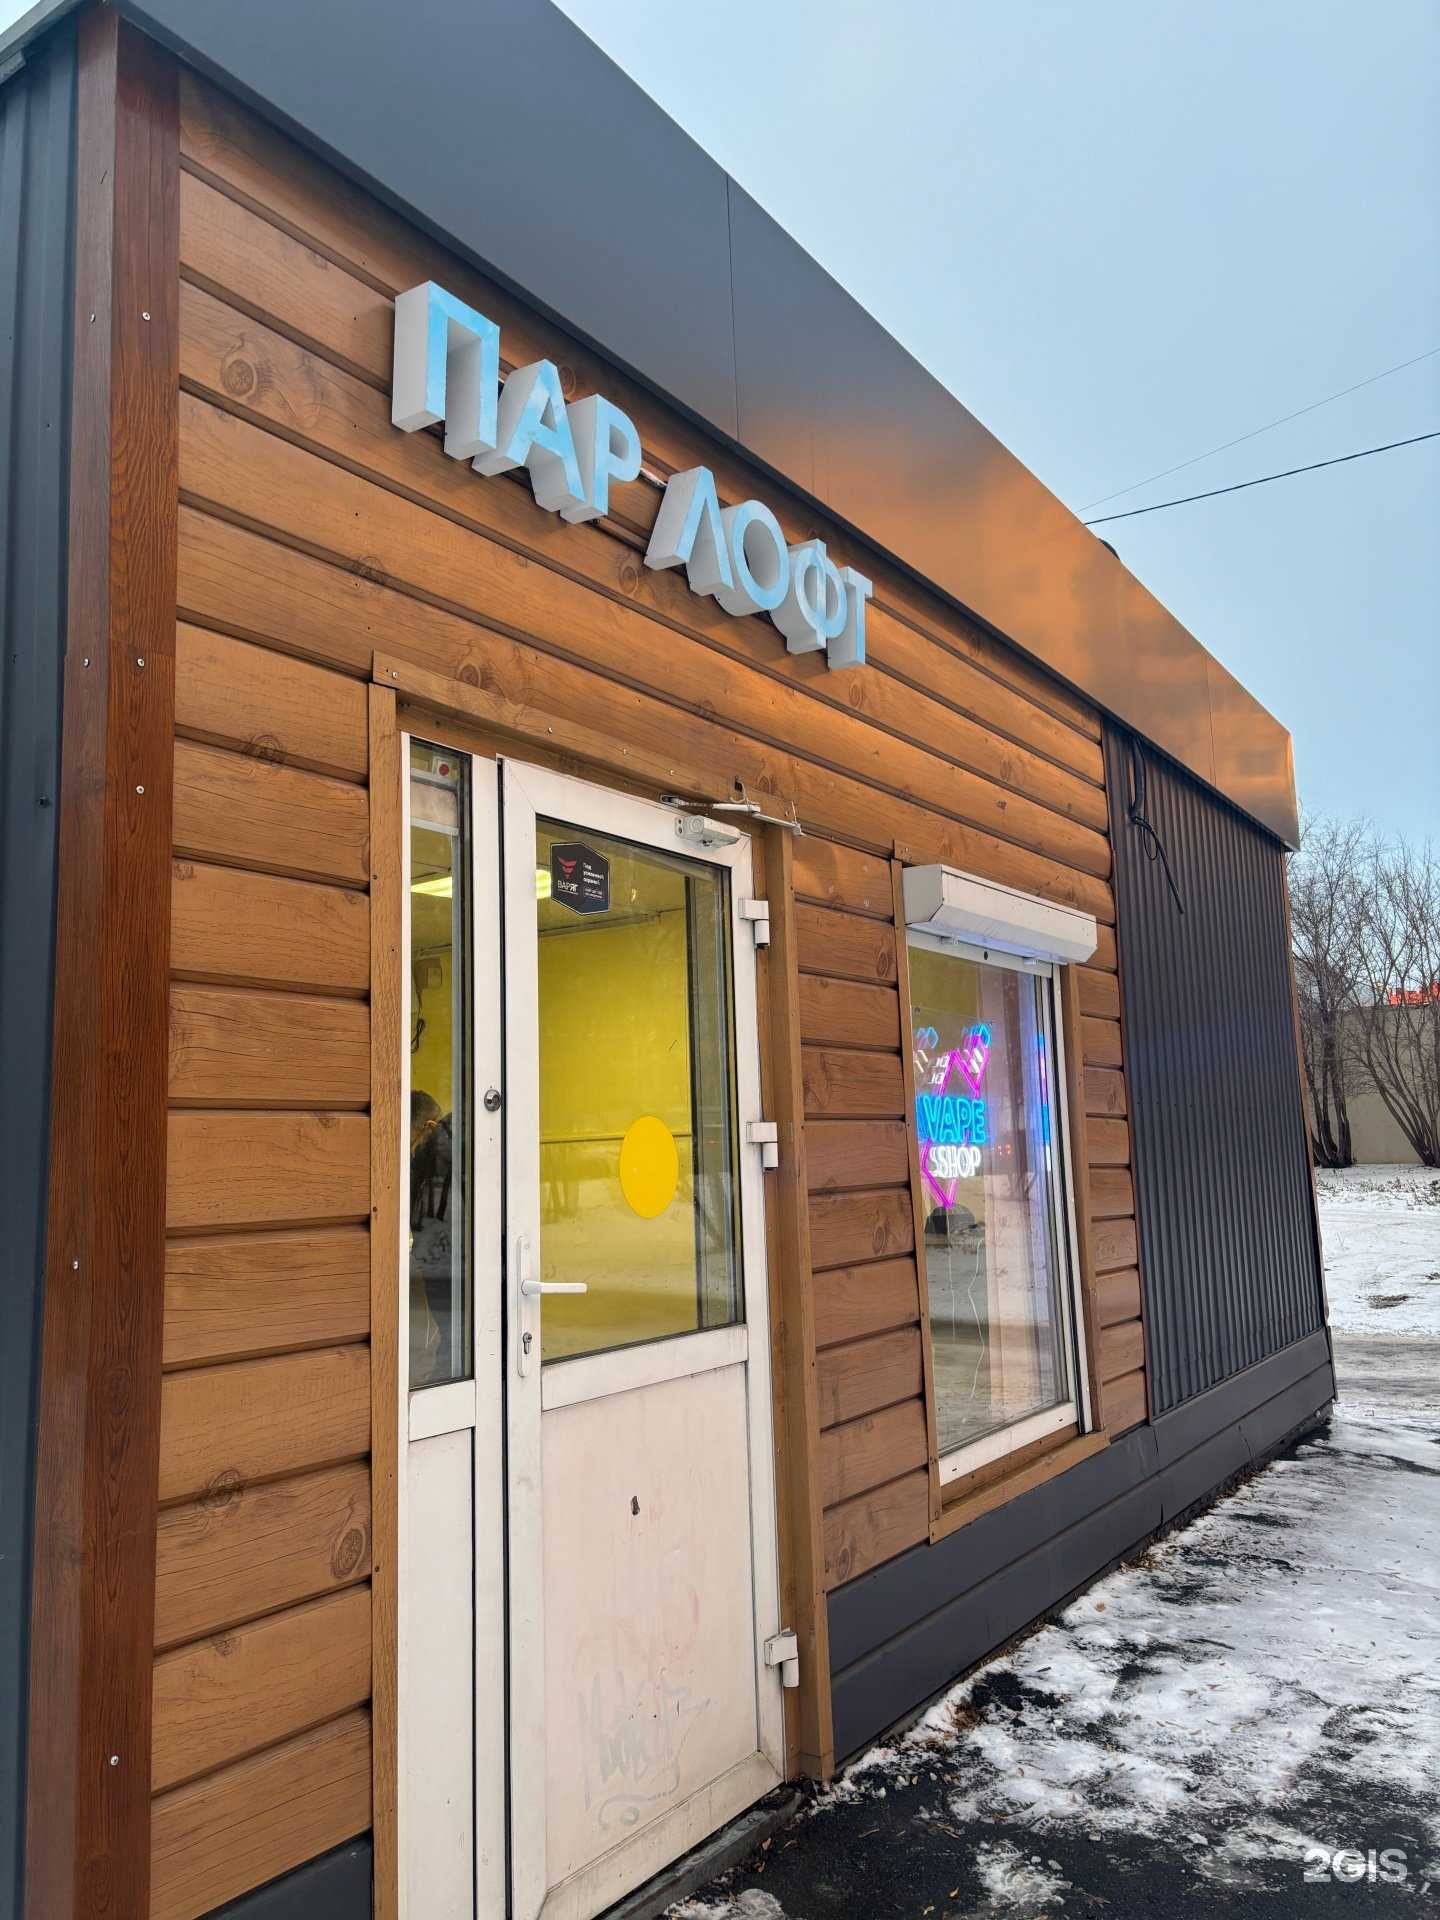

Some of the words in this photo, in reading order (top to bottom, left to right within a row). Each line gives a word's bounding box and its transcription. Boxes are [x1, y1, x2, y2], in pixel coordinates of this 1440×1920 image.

[393, 280, 642, 523] ПАР
[646, 465, 873, 671] ЛОФТ
[922, 1096, 986, 1143] VAPE
[932, 1146, 981, 1178] SHOP
